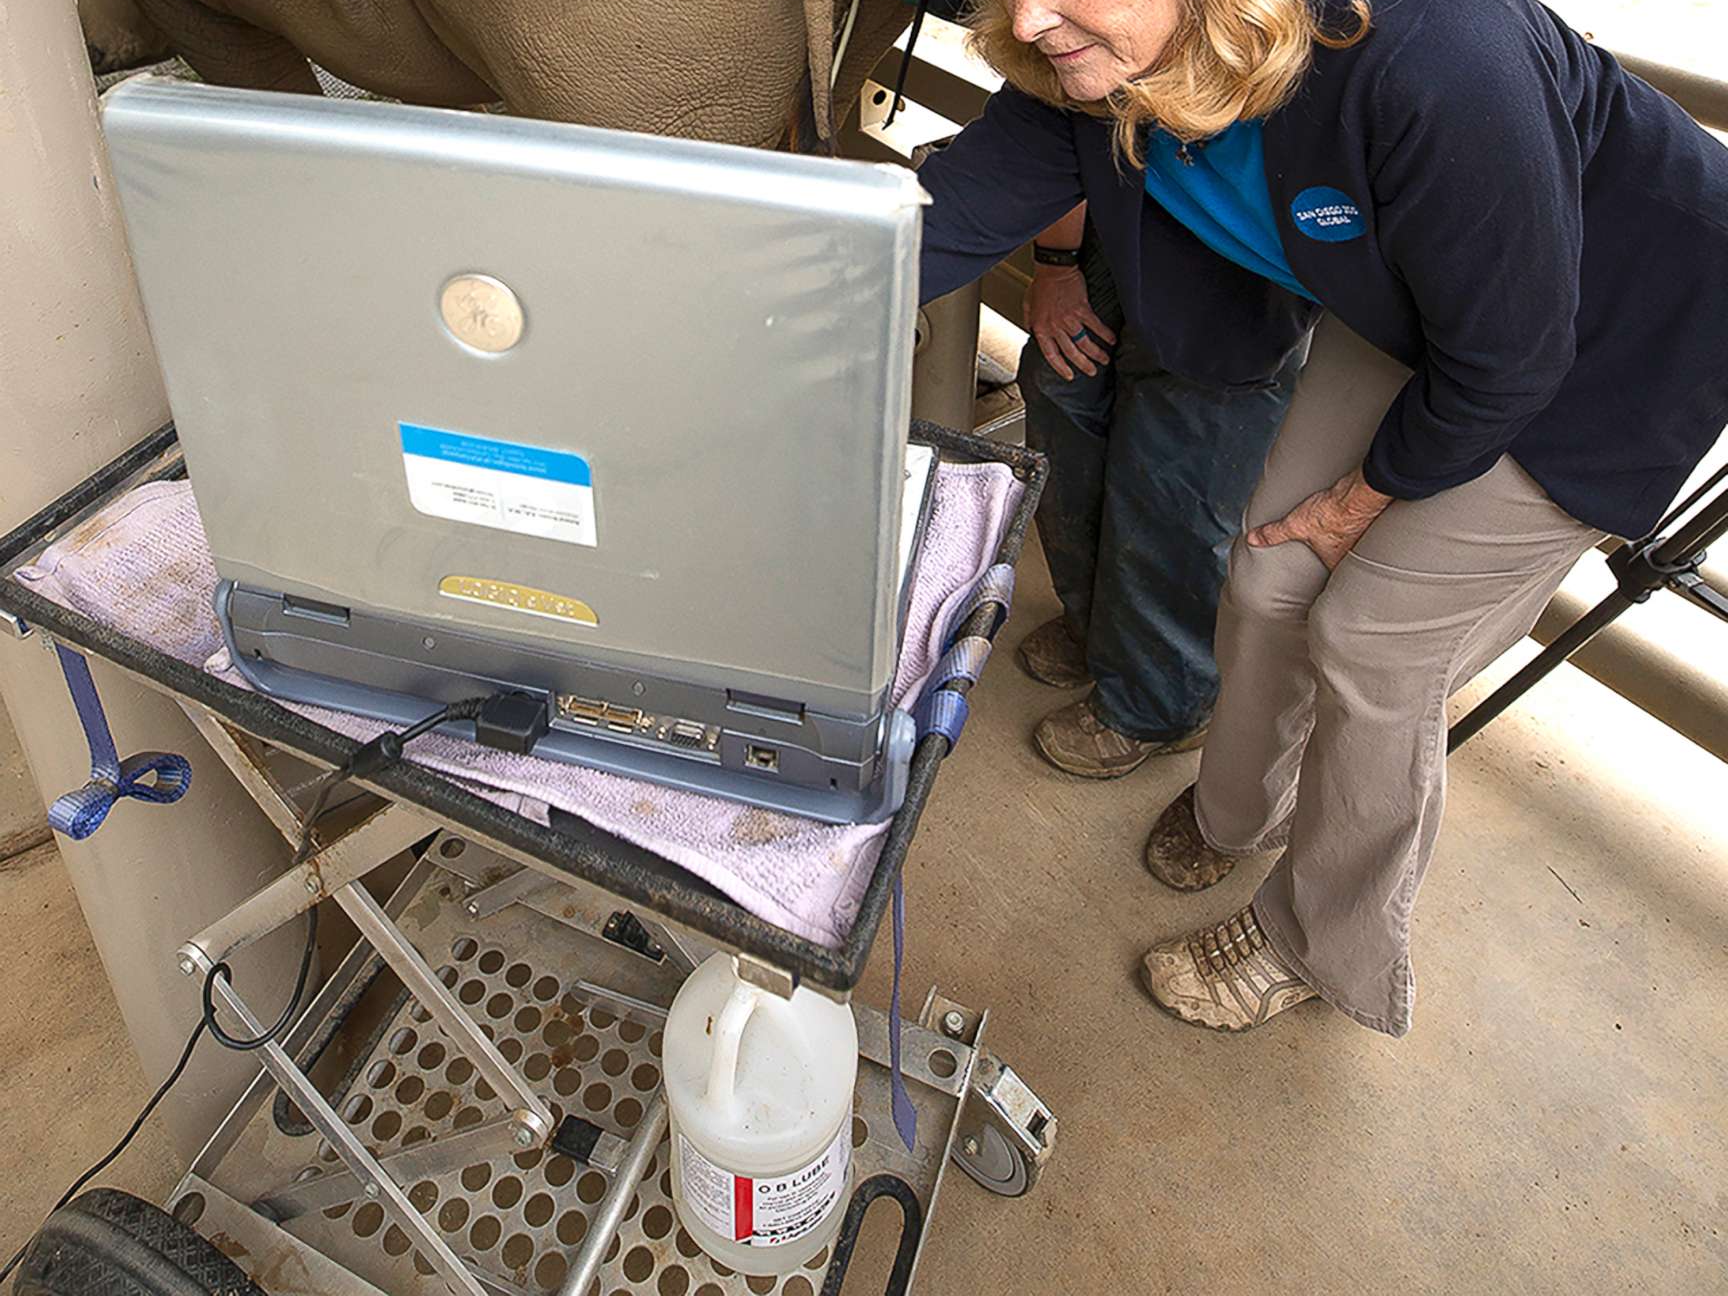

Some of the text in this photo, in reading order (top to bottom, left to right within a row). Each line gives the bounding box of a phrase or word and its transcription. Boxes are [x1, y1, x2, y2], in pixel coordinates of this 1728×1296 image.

[1296, 211, 1316, 221] SAN
[1315, 205, 1343, 216] DIEGO
[1317, 215, 1351, 226] GLOBAL
[792, 1154, 830, 1188] LUBE
